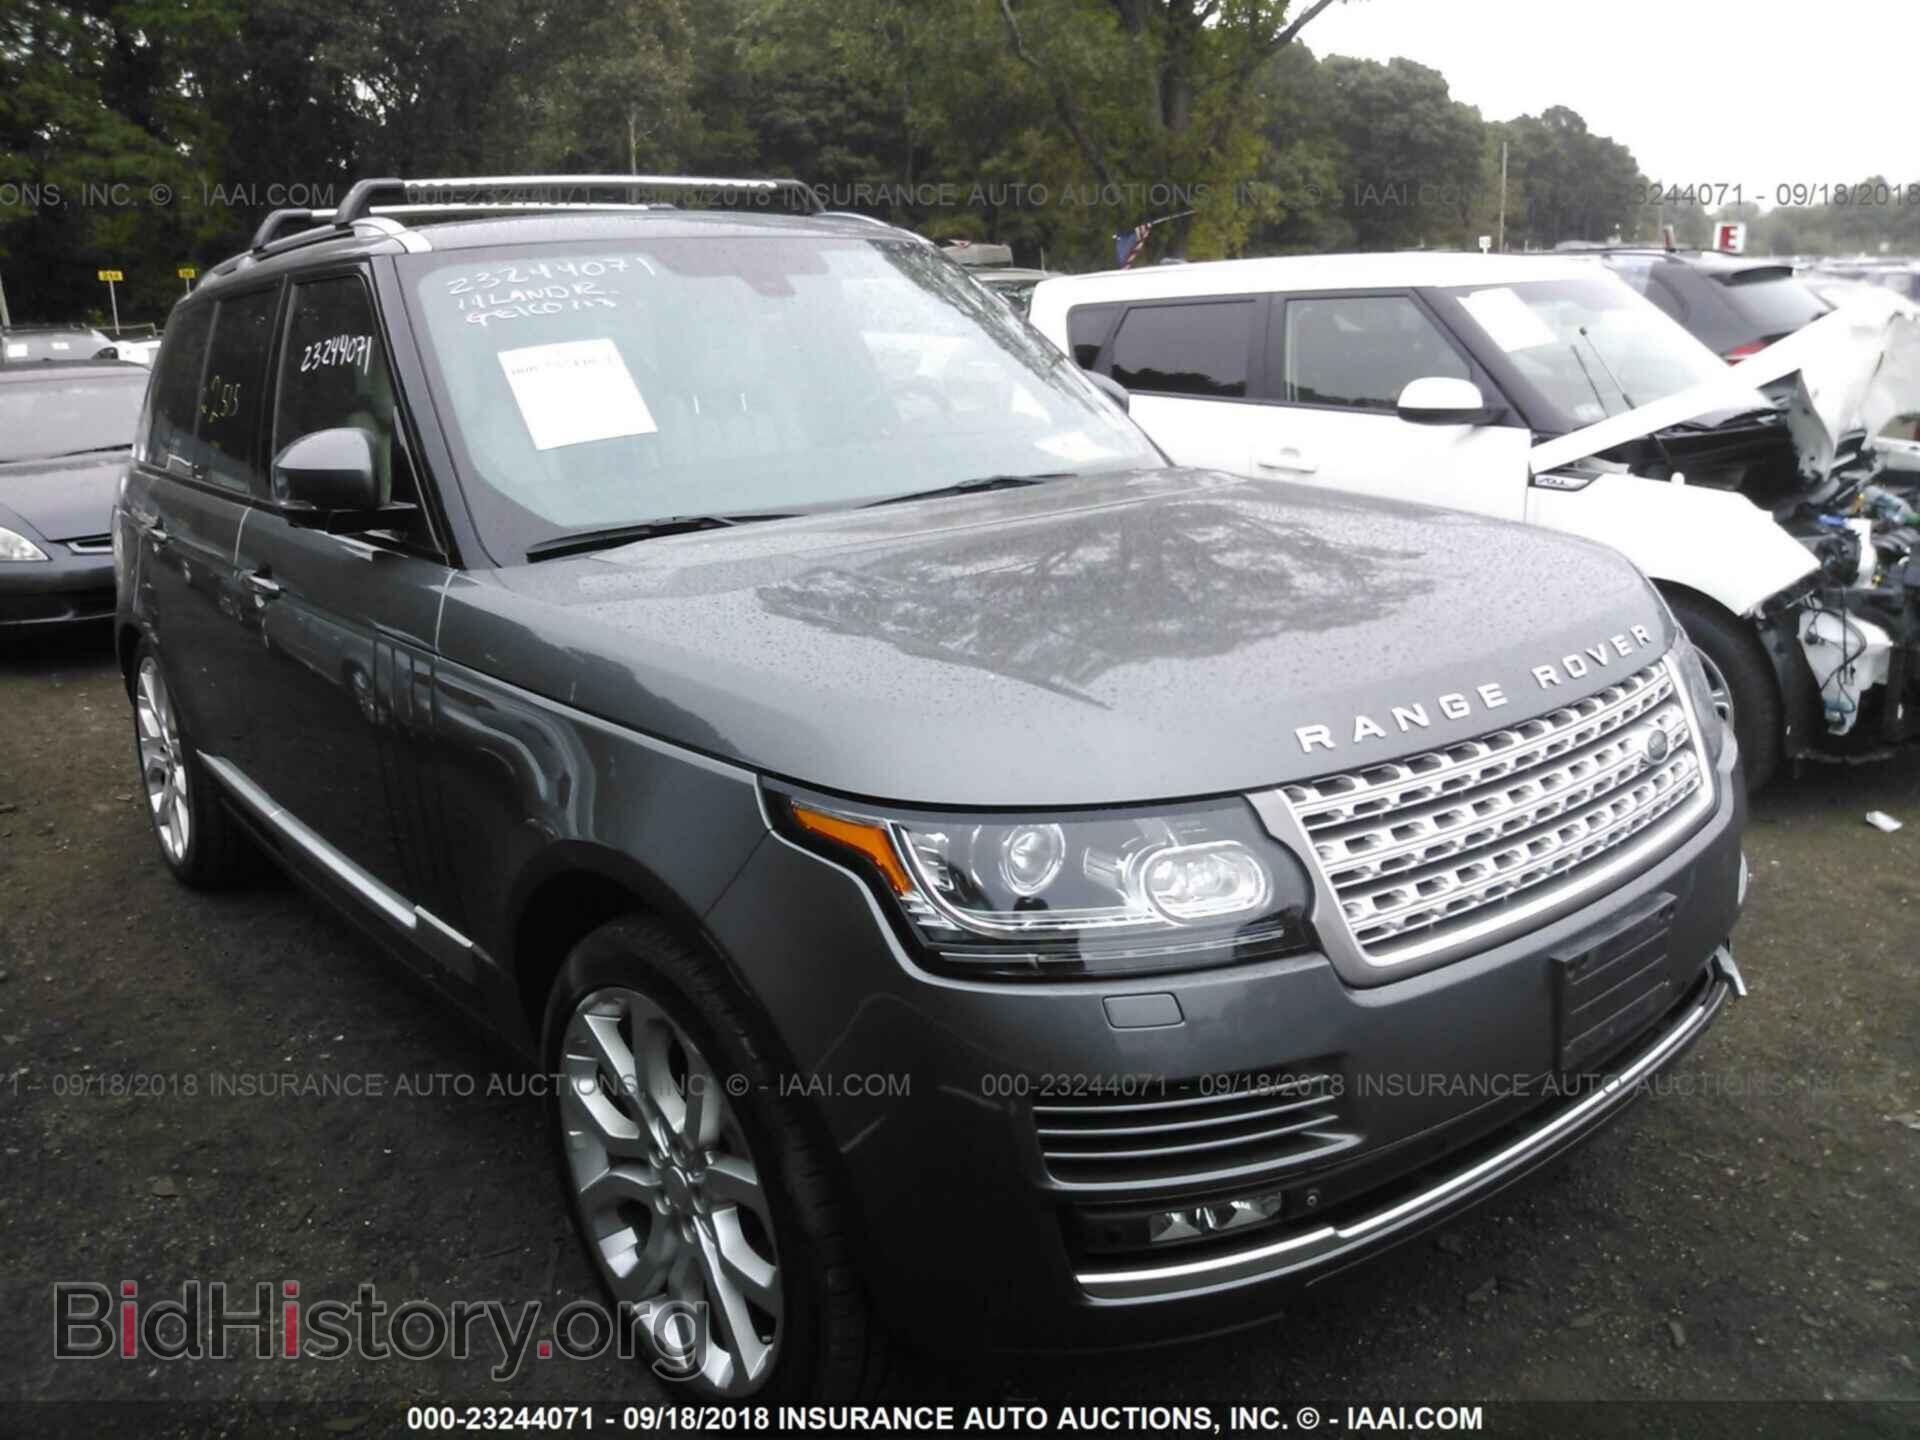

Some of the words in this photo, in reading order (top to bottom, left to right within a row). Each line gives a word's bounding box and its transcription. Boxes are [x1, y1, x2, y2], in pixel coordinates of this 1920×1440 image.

[447, 257, 655, 295] 23244071
[301, 334, 372, 375] 23244071
[1295, 682, 1508, 753] RANGE
[1531, 624, 1652, 688] ROVER
